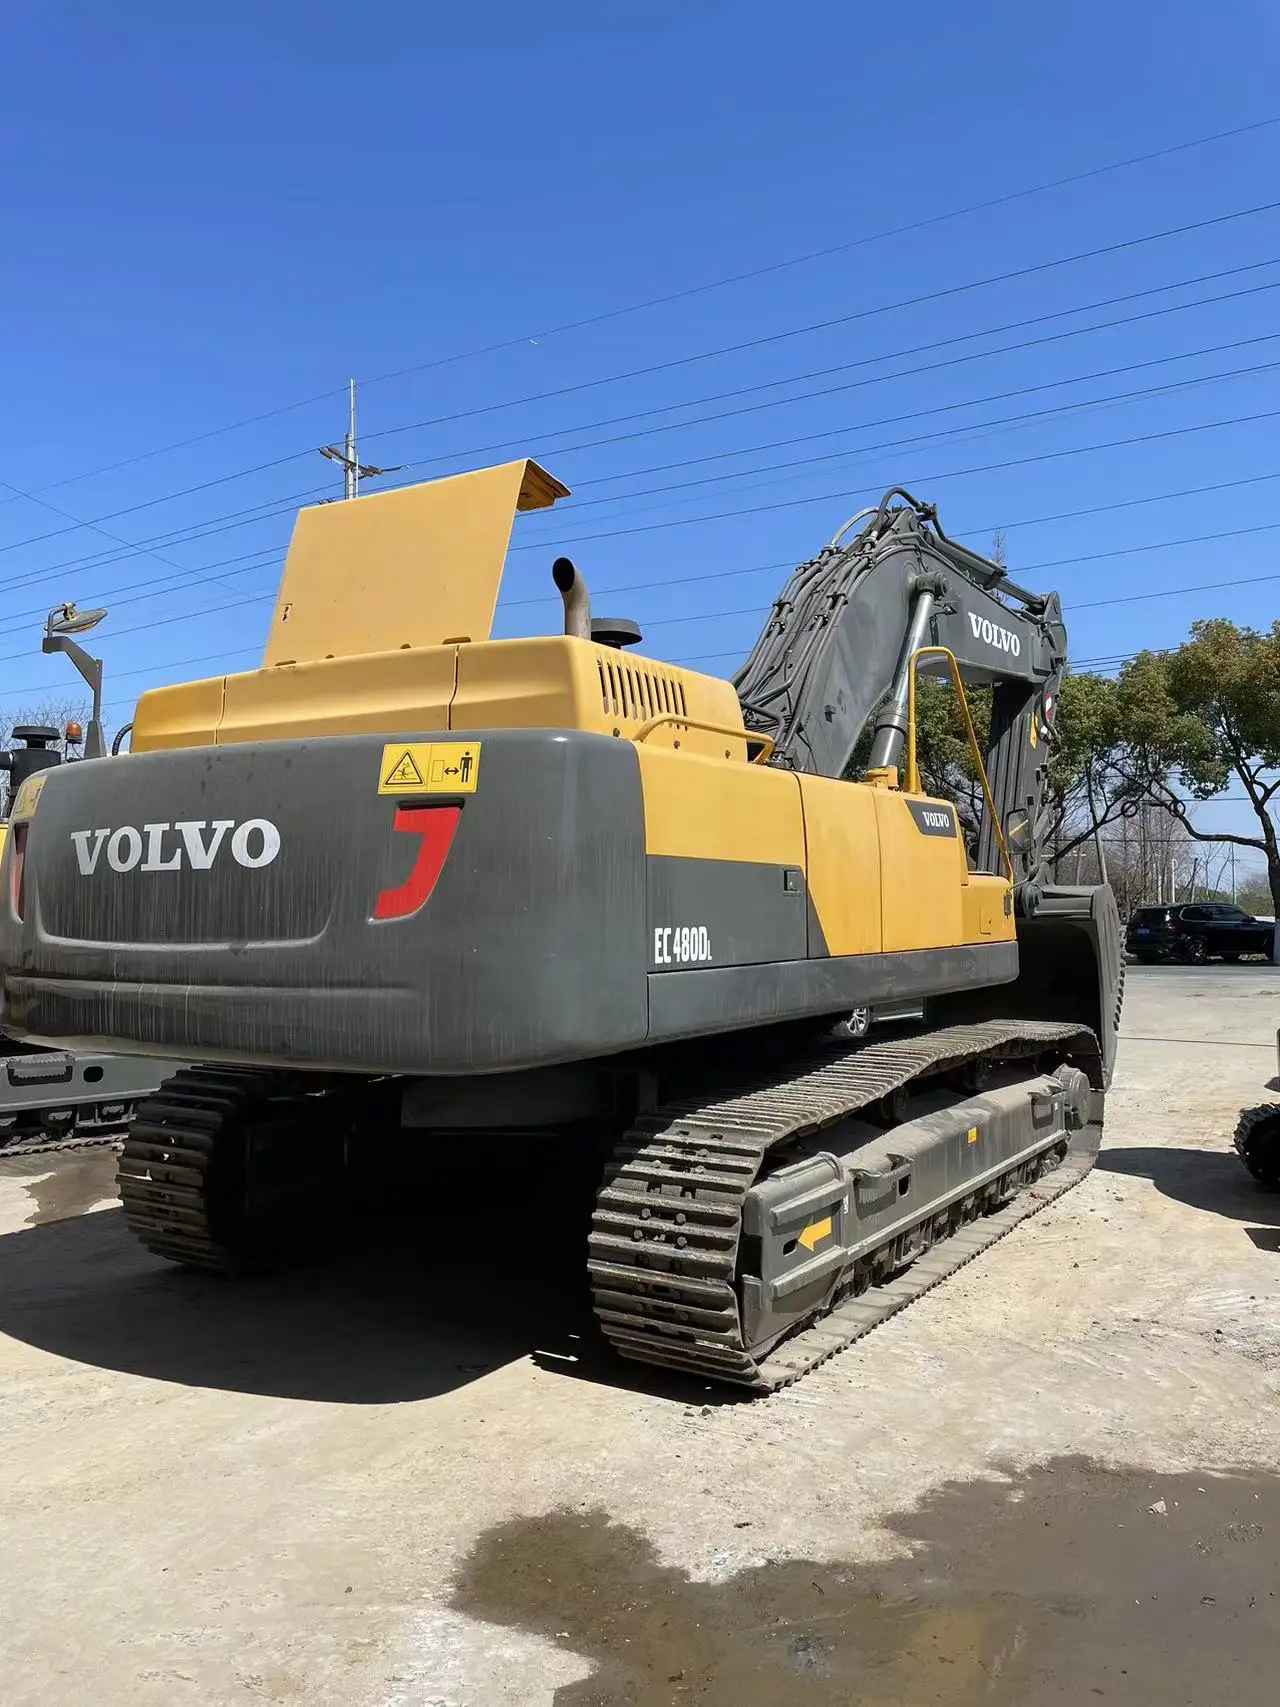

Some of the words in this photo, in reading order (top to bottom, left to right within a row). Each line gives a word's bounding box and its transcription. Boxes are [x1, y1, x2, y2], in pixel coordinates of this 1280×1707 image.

[968, 611, 1020, 657] VOLVO
[922, 811, 949, 828] VOLVO
[70, 818, 281, 876] VOLVO
